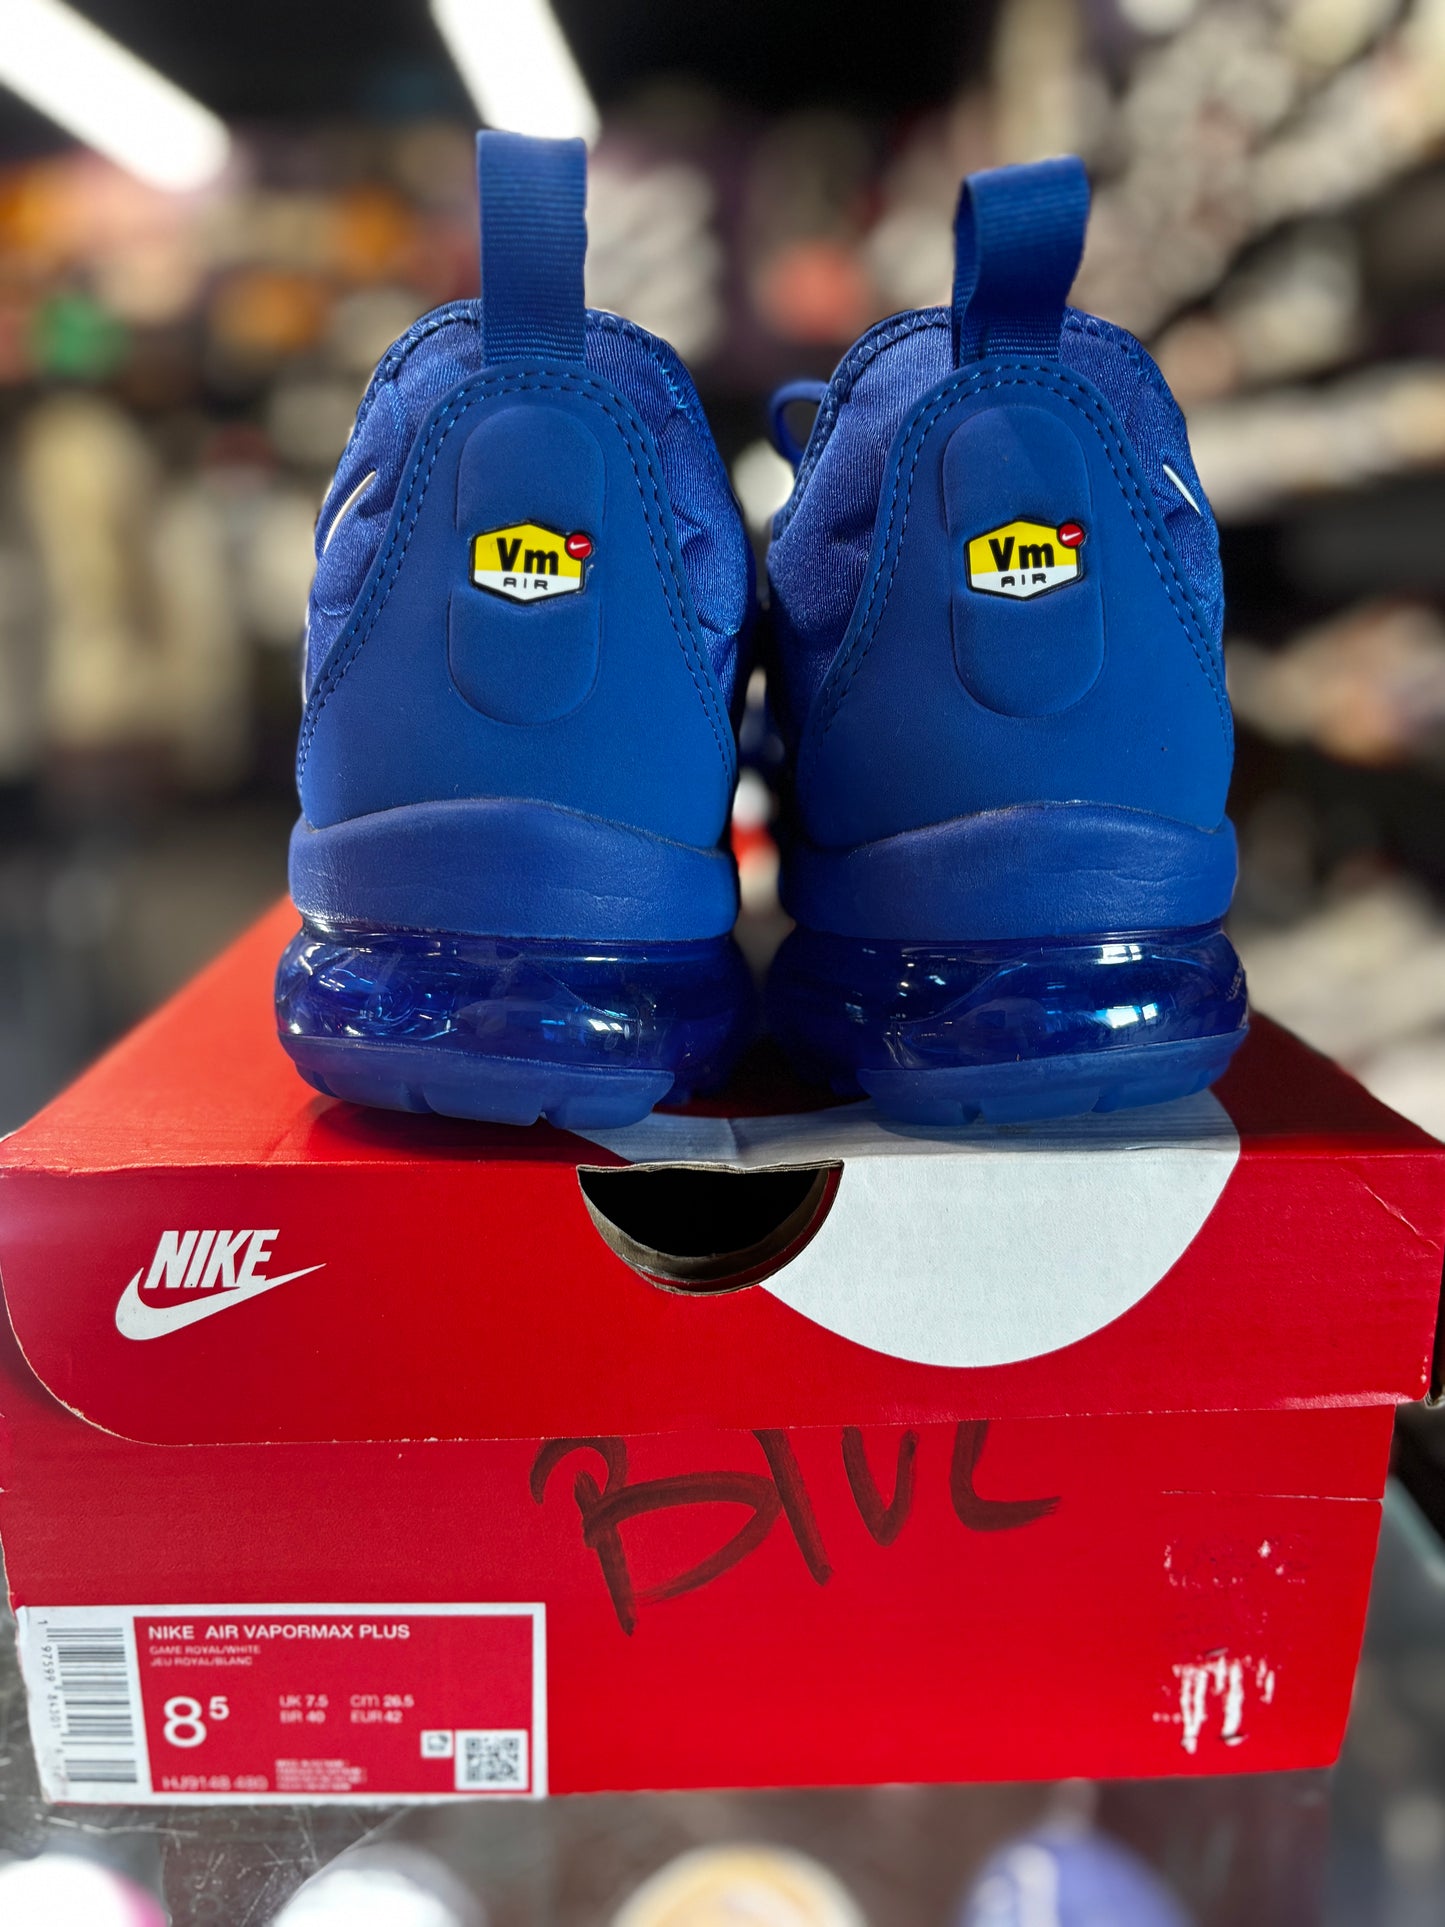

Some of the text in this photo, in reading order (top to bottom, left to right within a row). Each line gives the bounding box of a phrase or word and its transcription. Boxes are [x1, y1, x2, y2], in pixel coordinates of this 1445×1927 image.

[496, 537, 559, 577] Vm
[988, 536, 1055, 572] Vm
[503, 577, 549, 591] AIR
[1001, 573, 1047, 588] AIR
[143, 1229, 281, 1290] NIKE
[148, 1624, 411, 1640] NIKE AIR VAPORMAX PLUS
[150, 1644, 261, 1656] GAME ROYAL/WHITE
[279, 1694, 329, 1708] UK 7.5
[350, 1710, 382, 1723] EUR
